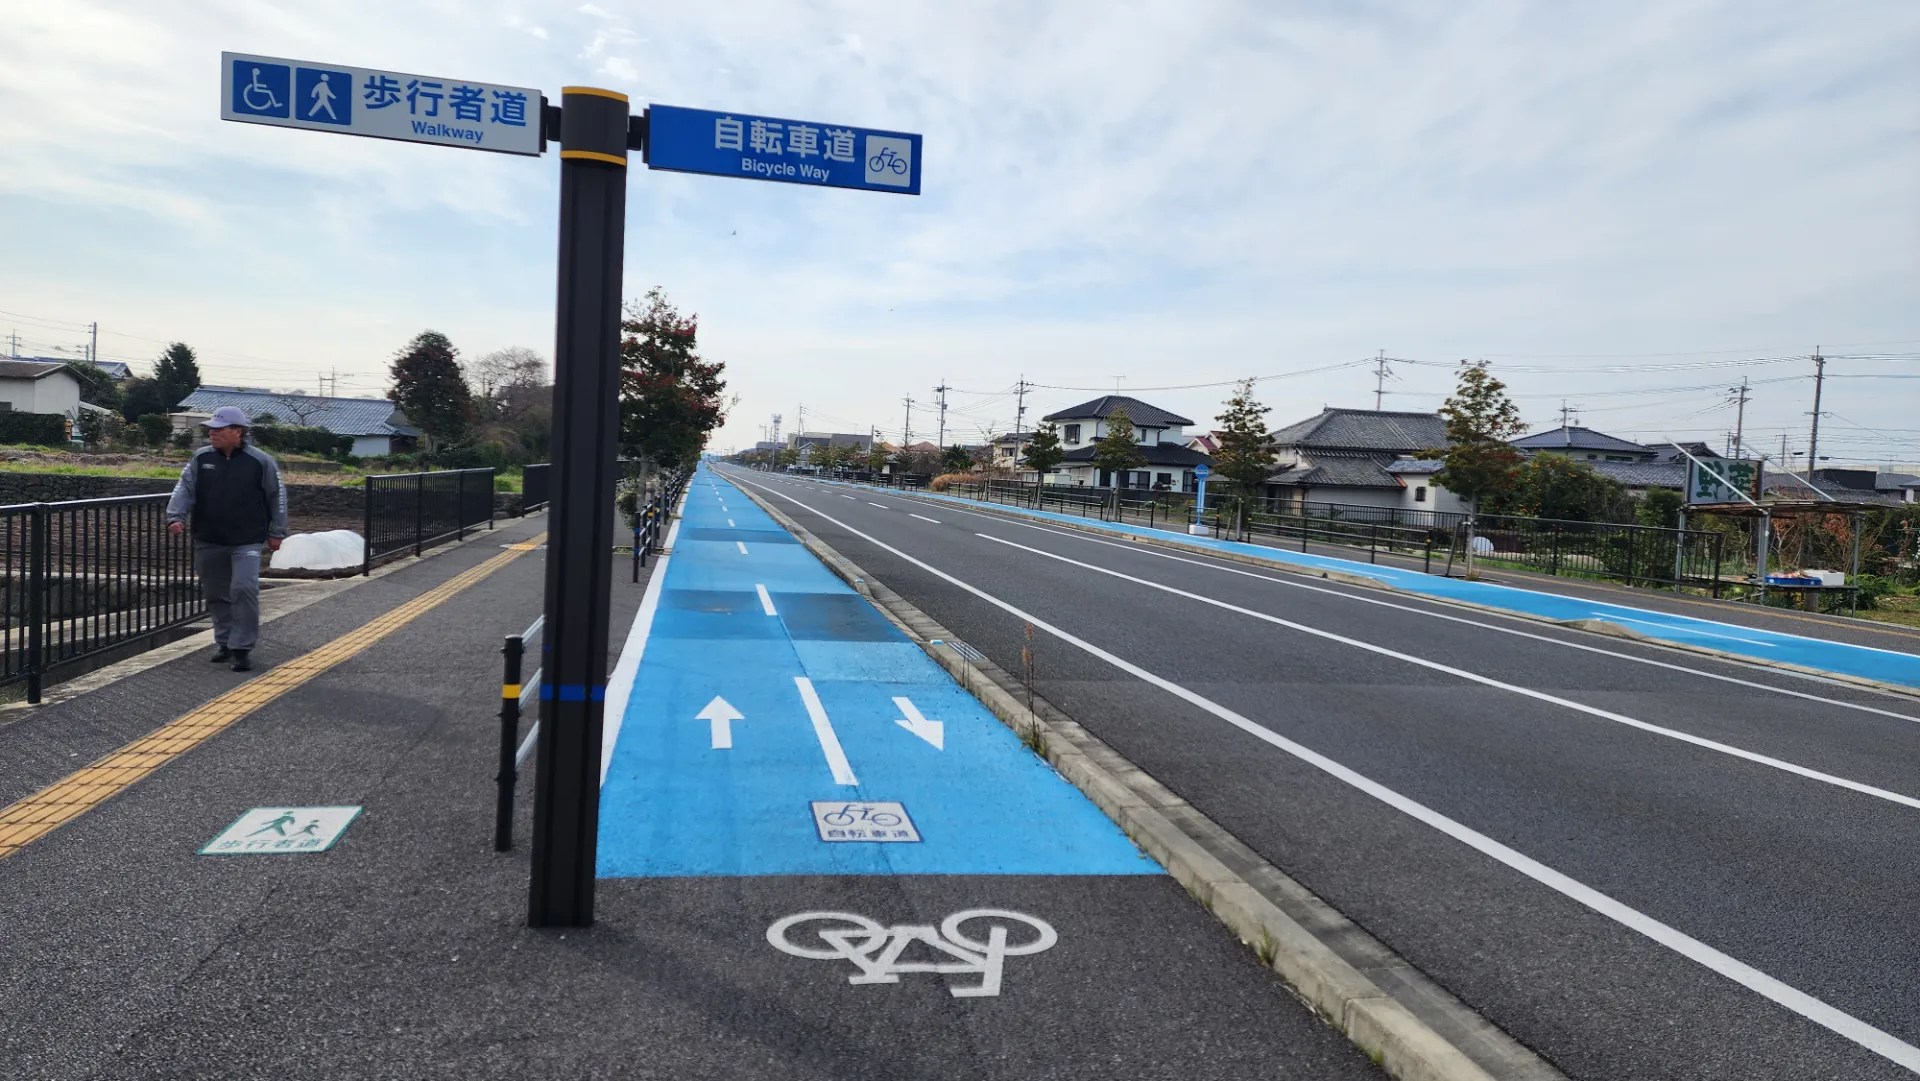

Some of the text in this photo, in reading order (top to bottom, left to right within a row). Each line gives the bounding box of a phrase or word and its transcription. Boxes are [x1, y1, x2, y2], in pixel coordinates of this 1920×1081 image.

[363, 75, 527, 127] 歩行者道
[411, 120, 484, 144] Walkway
[715, 116, 856, 163] 自転車道
[741, 157, 830, 182] Bicycle Way
[1696, 461, 1756, 501] 野菜
[216, 839, 325, 849] 歩行者道
[828, 829, 910, 839] 自転車道
